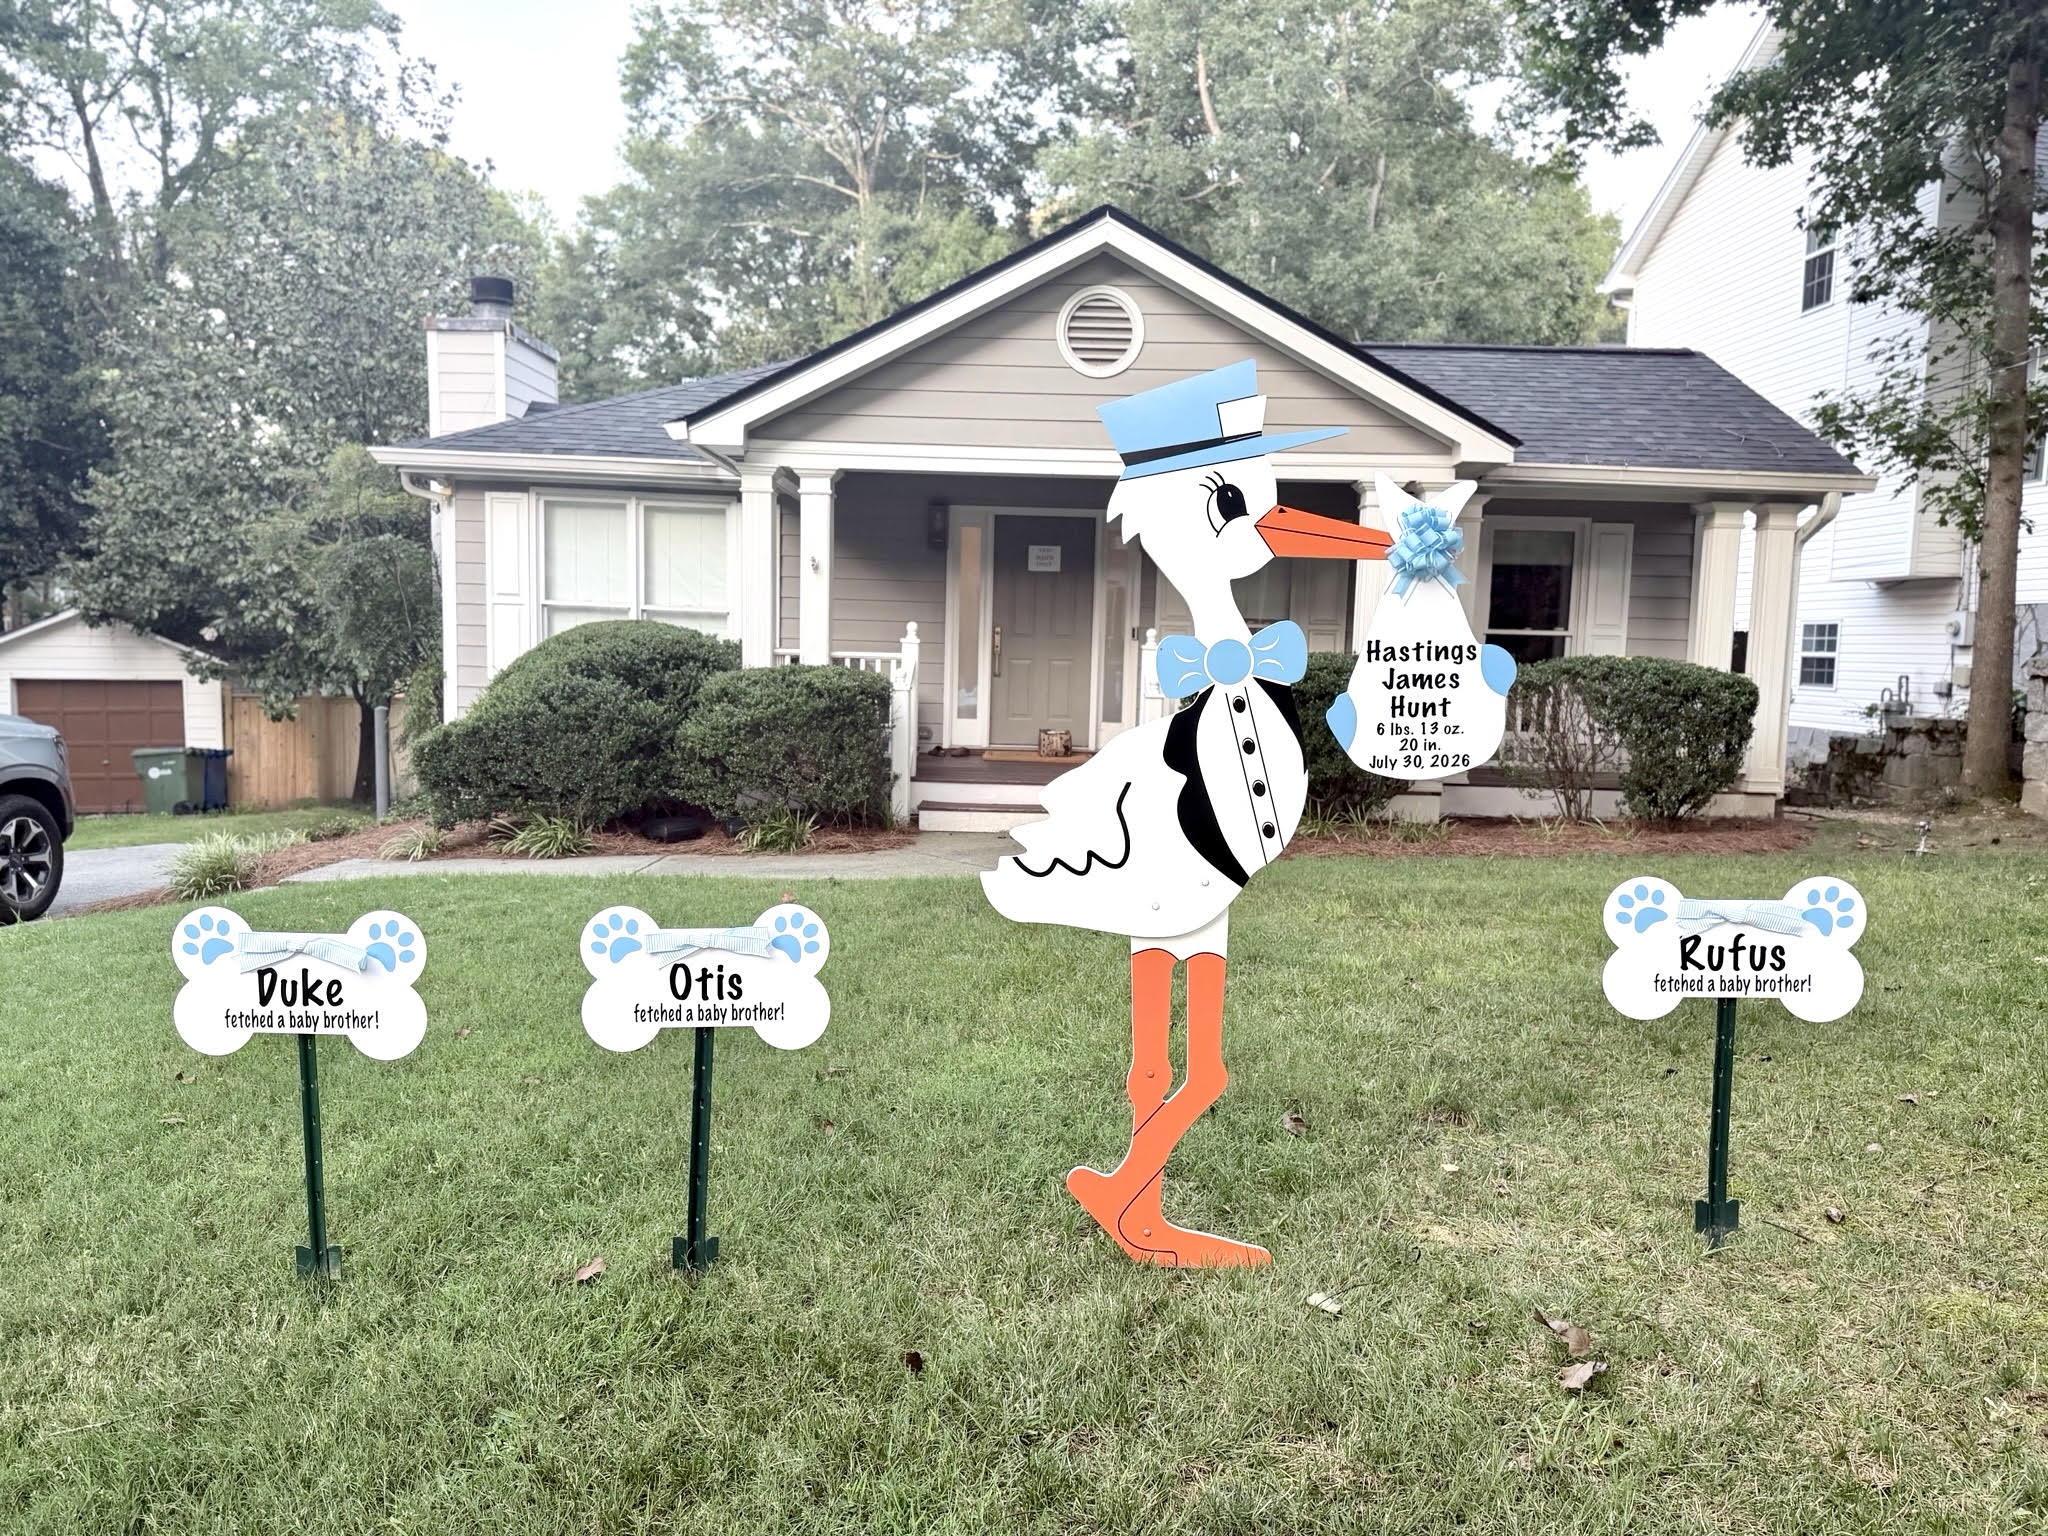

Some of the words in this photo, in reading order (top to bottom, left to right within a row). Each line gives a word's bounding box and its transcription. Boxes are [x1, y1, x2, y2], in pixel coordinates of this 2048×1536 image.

[1366, 639, 1477, 665] Hastings
[1381, 667, 1460, 690] James
[1390, 695, 1451, 718] Hunt
[1376, 722, 1385, 736] 6
[1390, 722, 1414, 736] lbs.
[1421, 721, 1439, 735] 13
[1443, 725, 1464, 735] oz.
[1398, 738, 1419, 752] 20
[1423, 738, 1441, 751] in.
[1368, 755, 1398, 771] July
[1403, 754, 1425, 770] 30,
[1429, 753, 1470, 768] 2026
[1679, 933, 1786, 972] Rufus
[256, 967, 344, 1008] Duke
[669, 962, 743, 1002] Otis
[1653, 973, 1704, 993] fetched
[1707, 979, 1716, 993] a
[1719, 974, 1751, 996] baby
[1755, 973, 1812, 993] brother!
[224, 1008, 274, 1029] fetched
[277, 1014, 286, 1029] a
[289, 1010, 320, 1032] baby
[323, 1009, 379, 1030] brother!
[633, 1003, 682, 1023] fetched
[685, 1008, 694, 1022] a
[697, 1003, 728, 1025] baby
[731, 1001, 785, 1022] brother!
